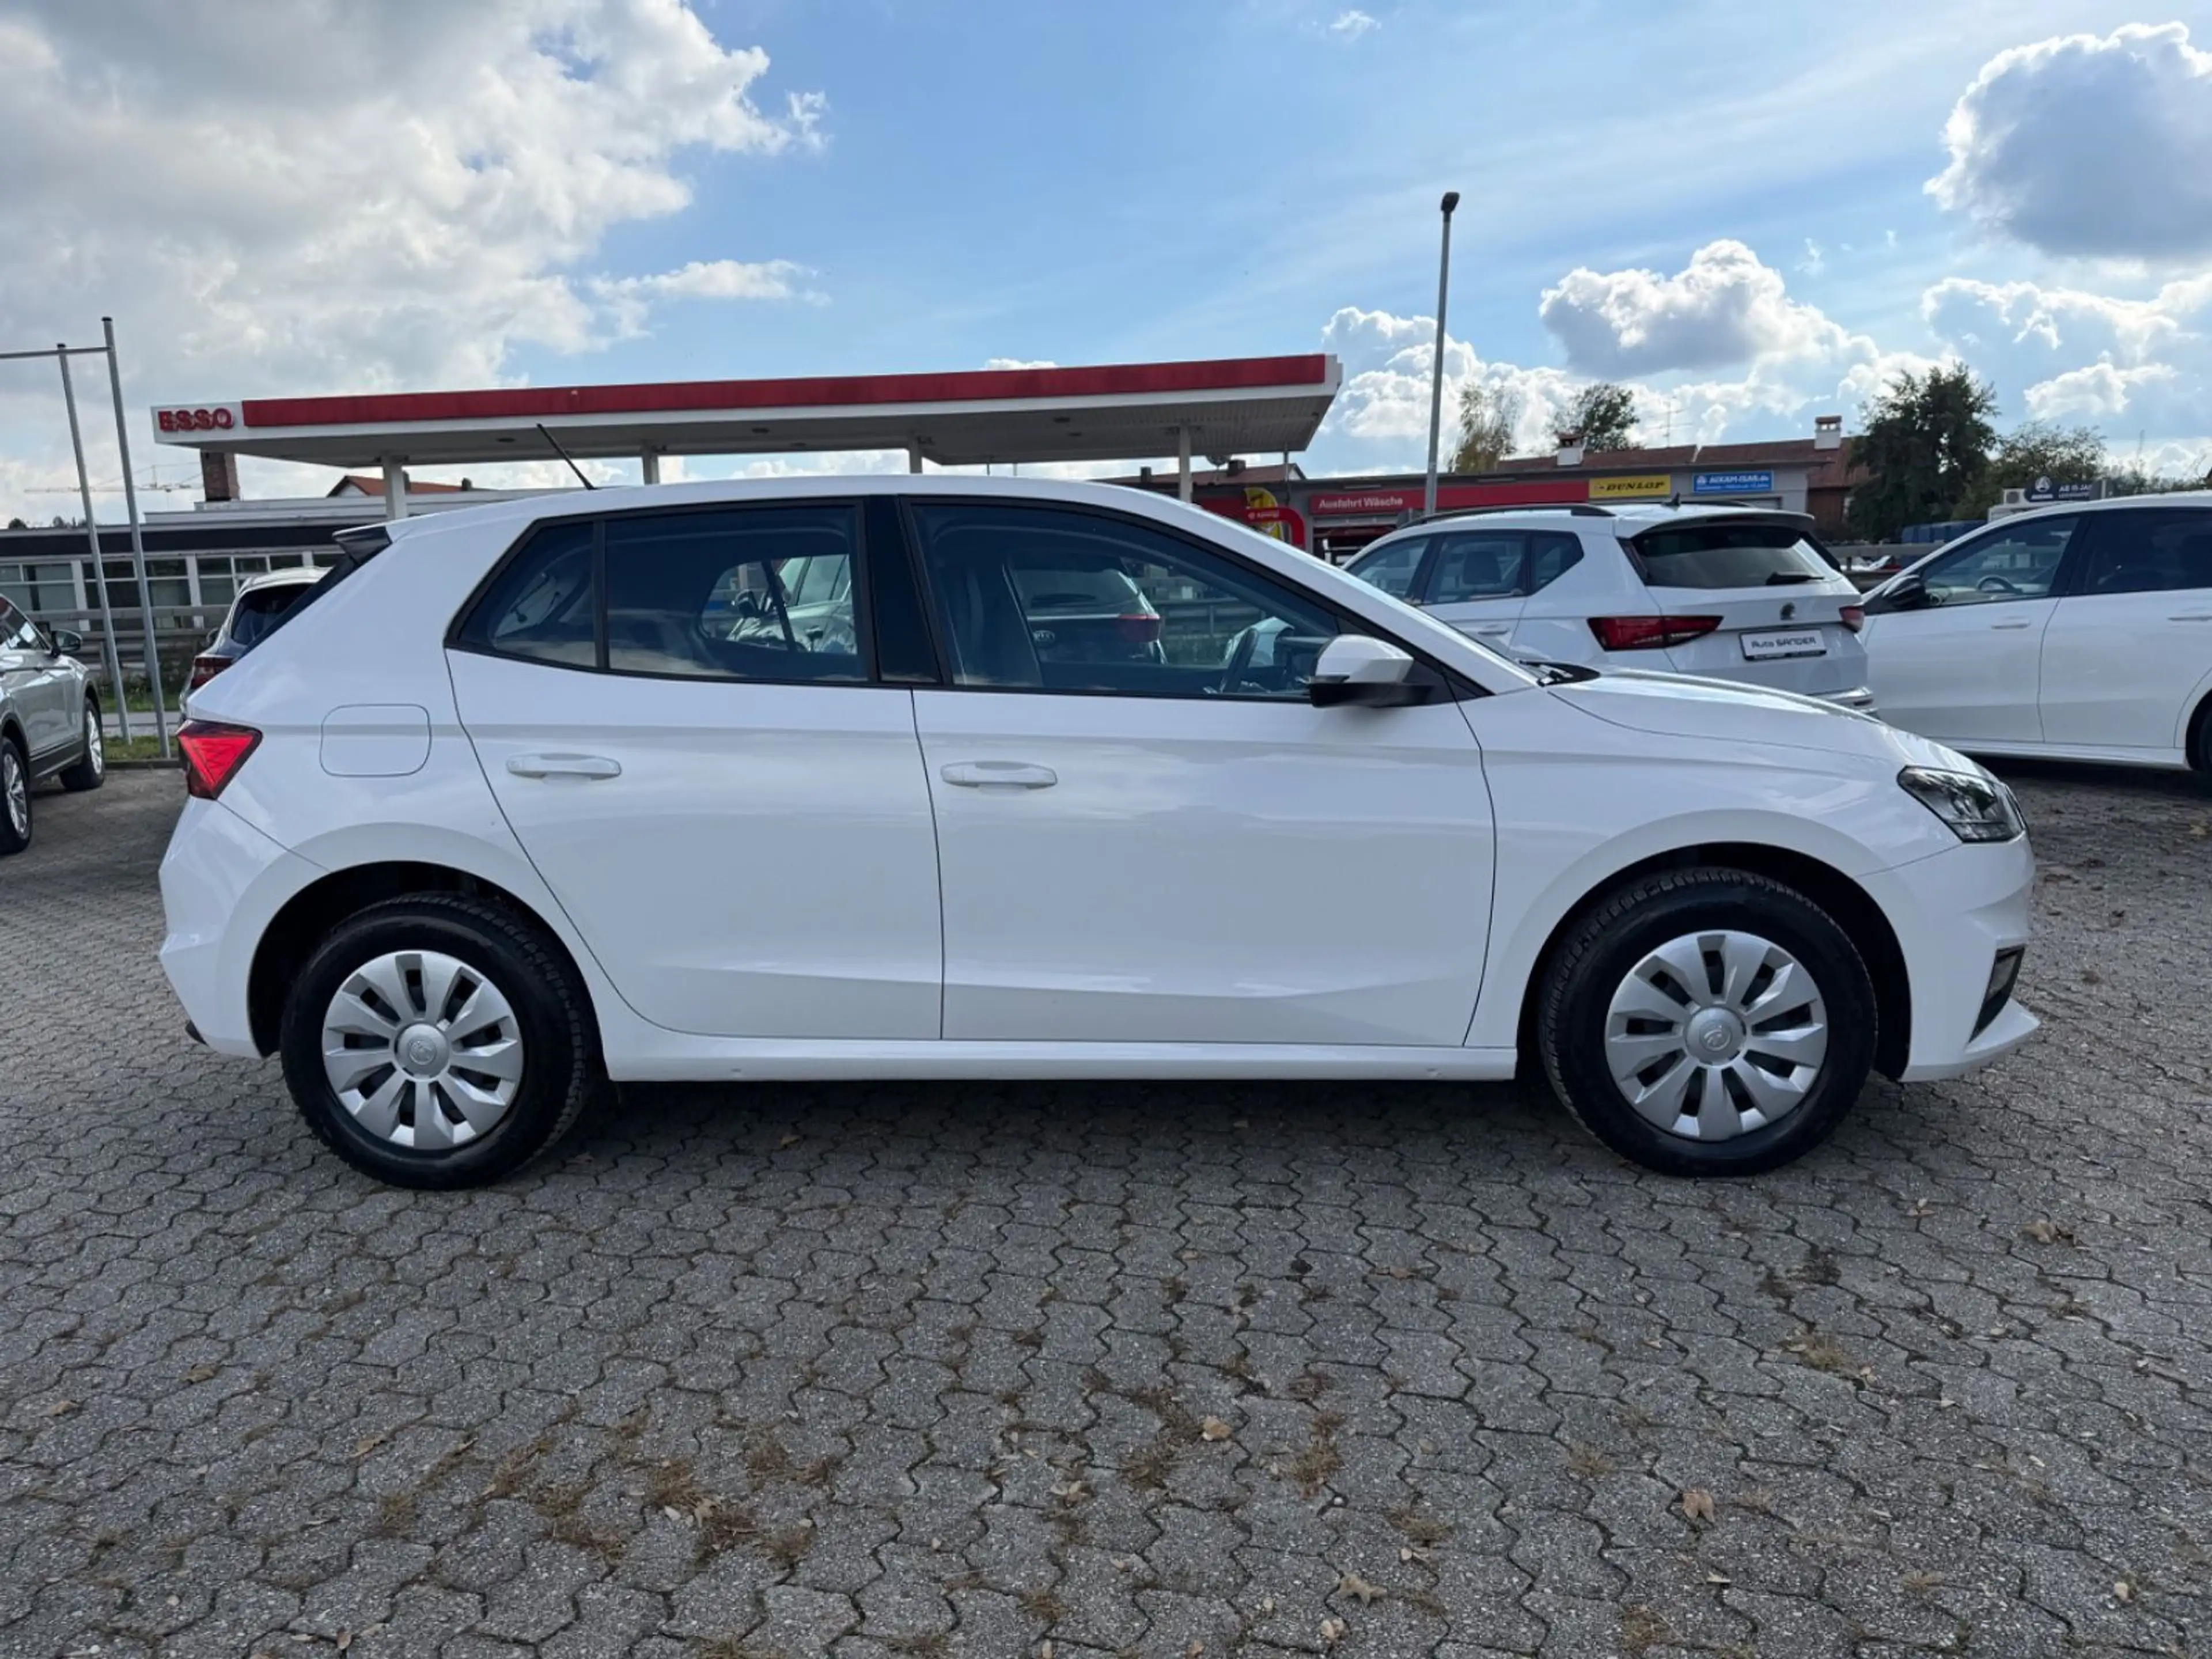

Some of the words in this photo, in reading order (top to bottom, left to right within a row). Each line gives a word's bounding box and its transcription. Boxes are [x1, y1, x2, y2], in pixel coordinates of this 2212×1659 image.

[158, 407, 234, 430] ESSO
[1607, 481, 1664, 491] DUNLOP
[1319, 497, 1362, 509] Ausfahrt
[1363, 495, 1403, 507] Wäsche
[1751, 640, 1774, 649] Auto
